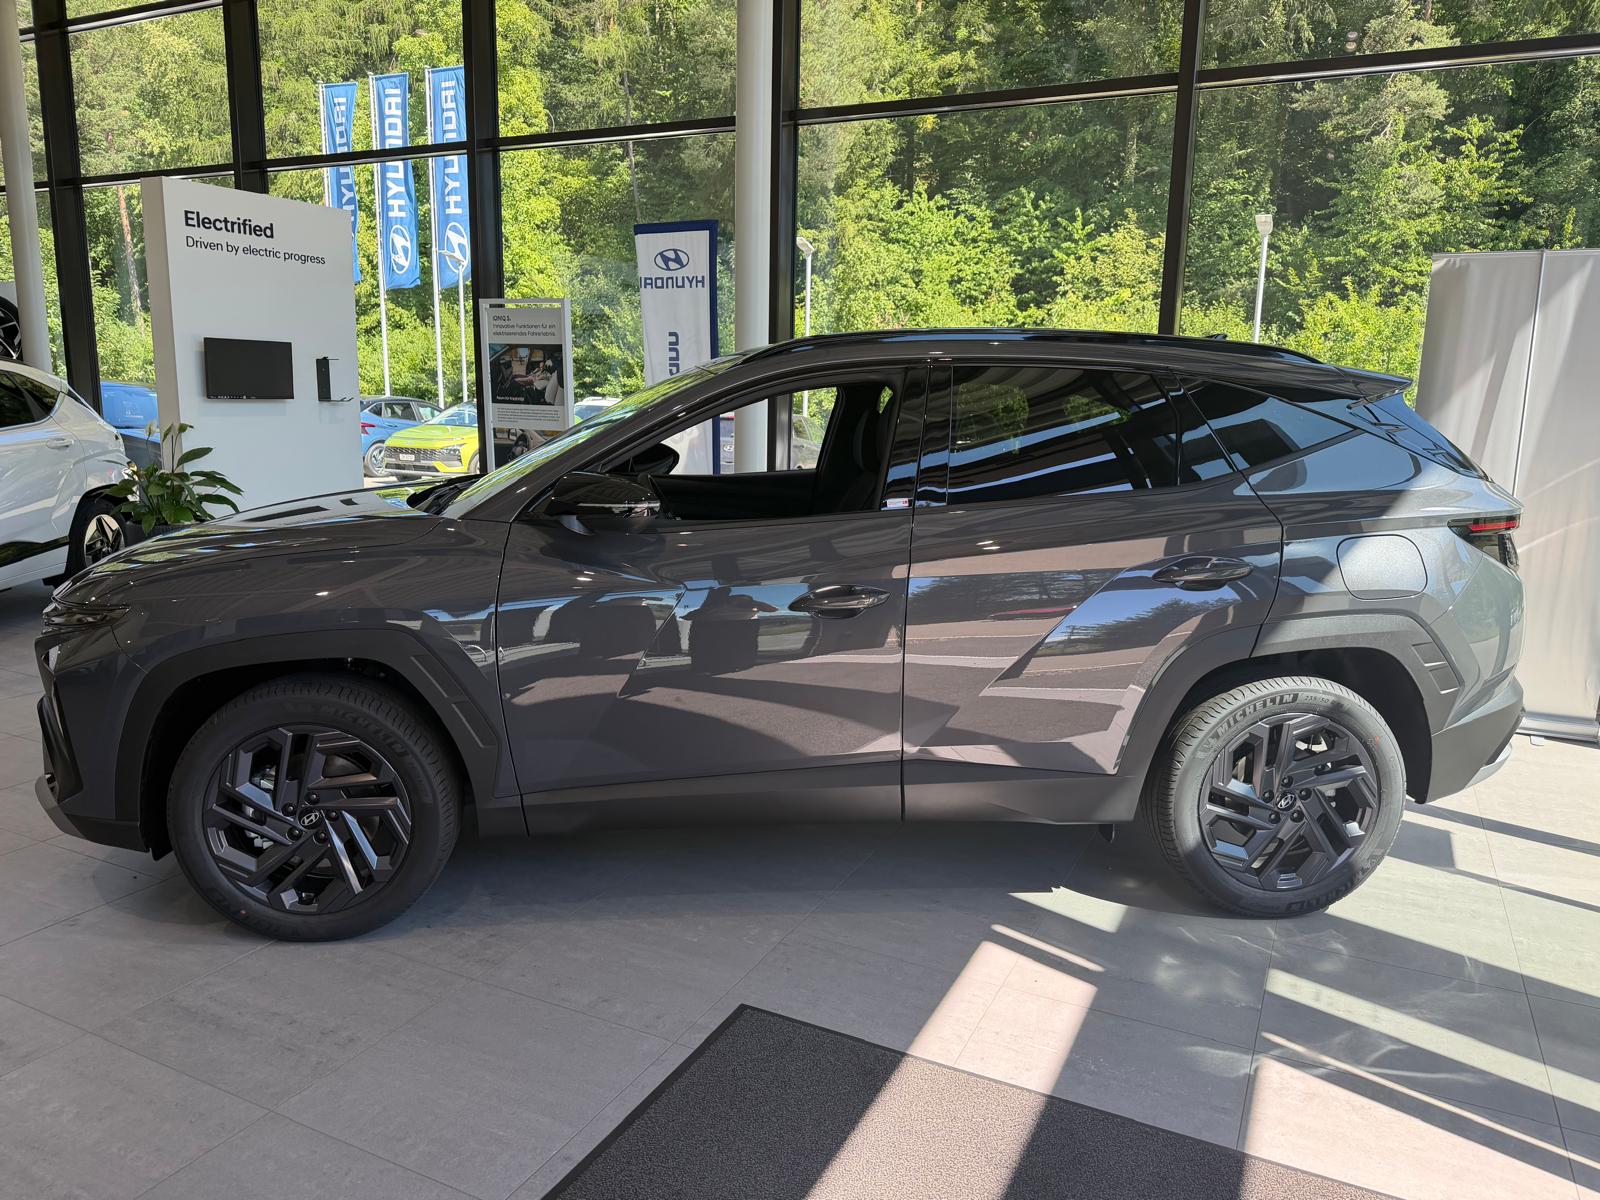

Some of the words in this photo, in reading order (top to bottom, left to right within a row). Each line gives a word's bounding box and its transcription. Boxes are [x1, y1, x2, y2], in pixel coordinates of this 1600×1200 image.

[184, 209, 274, 239] Electrified
[186, 235, 223, 252] Driven
[226, 241, 239, 256] by
[242, 244, 281, 259] electric
[283, 251, 326, 265] progress
[1216, 693, 1298, 738] MICHELIN
